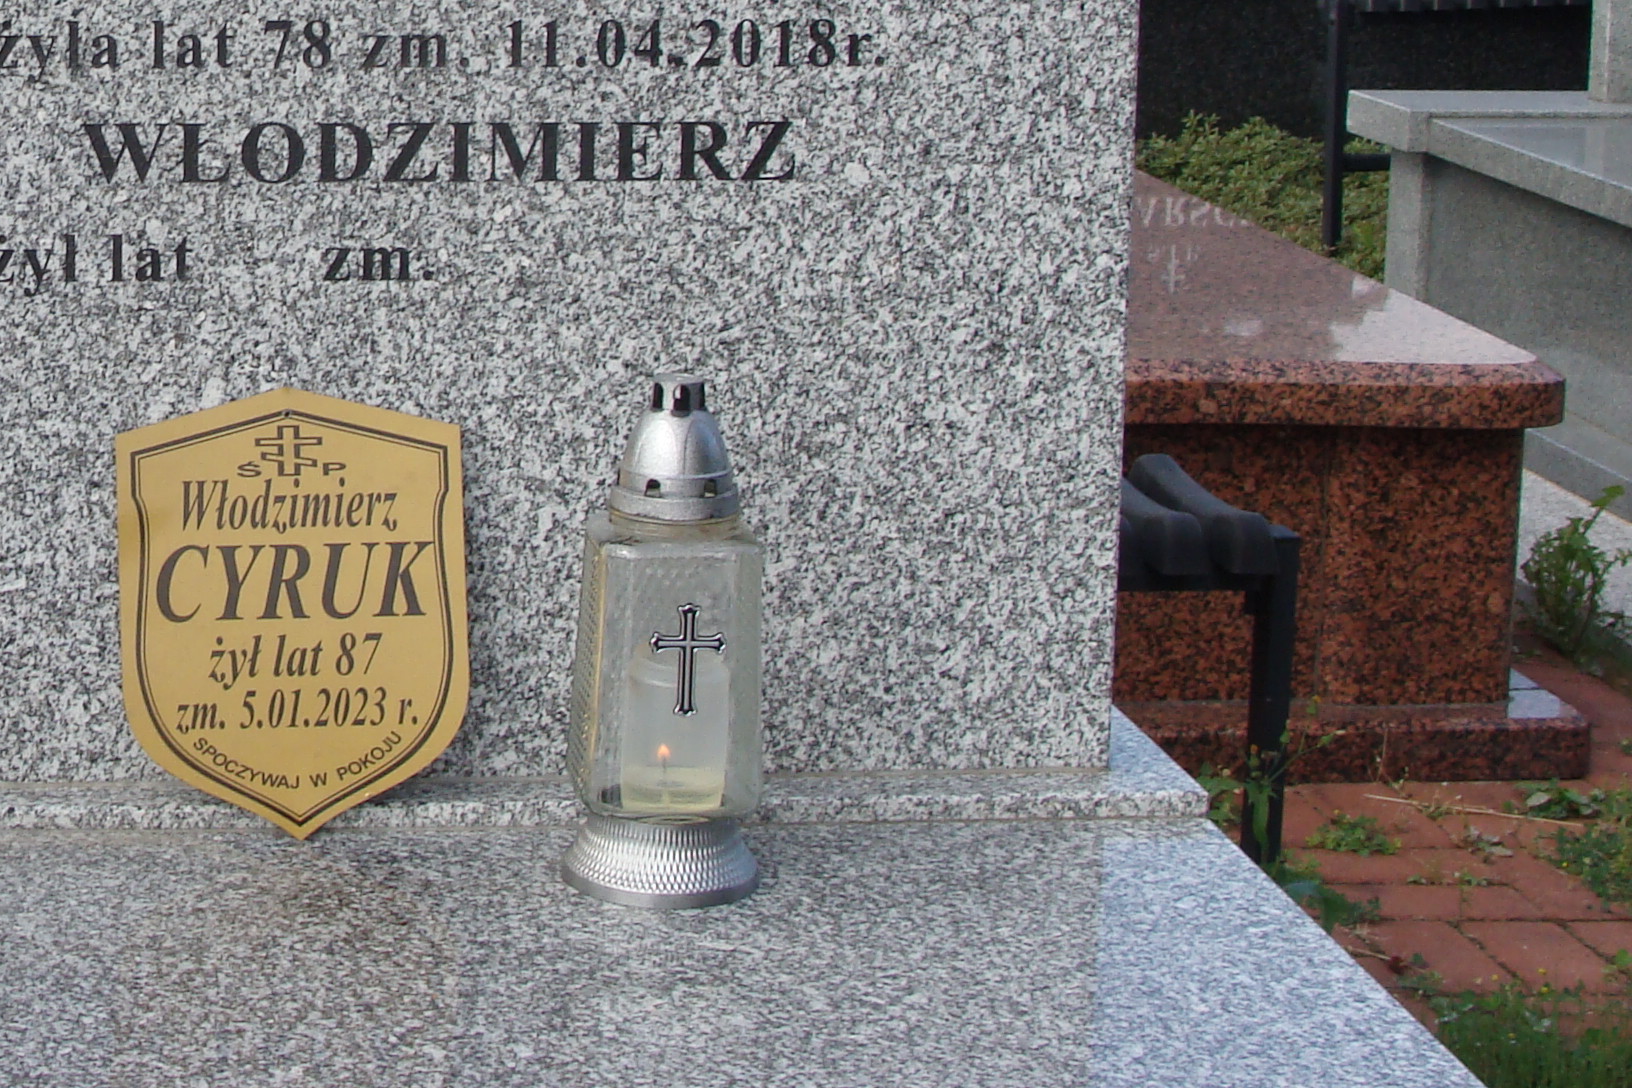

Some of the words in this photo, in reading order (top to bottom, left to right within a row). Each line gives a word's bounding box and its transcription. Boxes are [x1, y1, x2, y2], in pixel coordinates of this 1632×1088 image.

[152, 20, 235, 70] lat
[264, 19, 332, 70] 78
[362, 33, 469, 69] zm.
[82, 120, 797, 183] WŁODZIMIERZ
[110, 234, 194, 282] lat
[323, 244, 435, 281] zm.
[237, 461, 262, 477] Ś
[323, 463, 346, 476] P
[181, 475, 398, 534] Włodzimierz
[155, 541, 435, 623] CYRUK
[208, 635, 263, 690] żył
[273, 634, 324, 677] lat
[335, 632, 383, 675] 87
[176, 701, 226, 734] zm.
[239, 687, 387, 730] 5.01.2023
[398, 698, 419, 726] r.
[193, 736, 301, 790] SPOCZYWAJ
[310, 772, 328, 788] W
[337, 730, 402, 781] POKOJU
